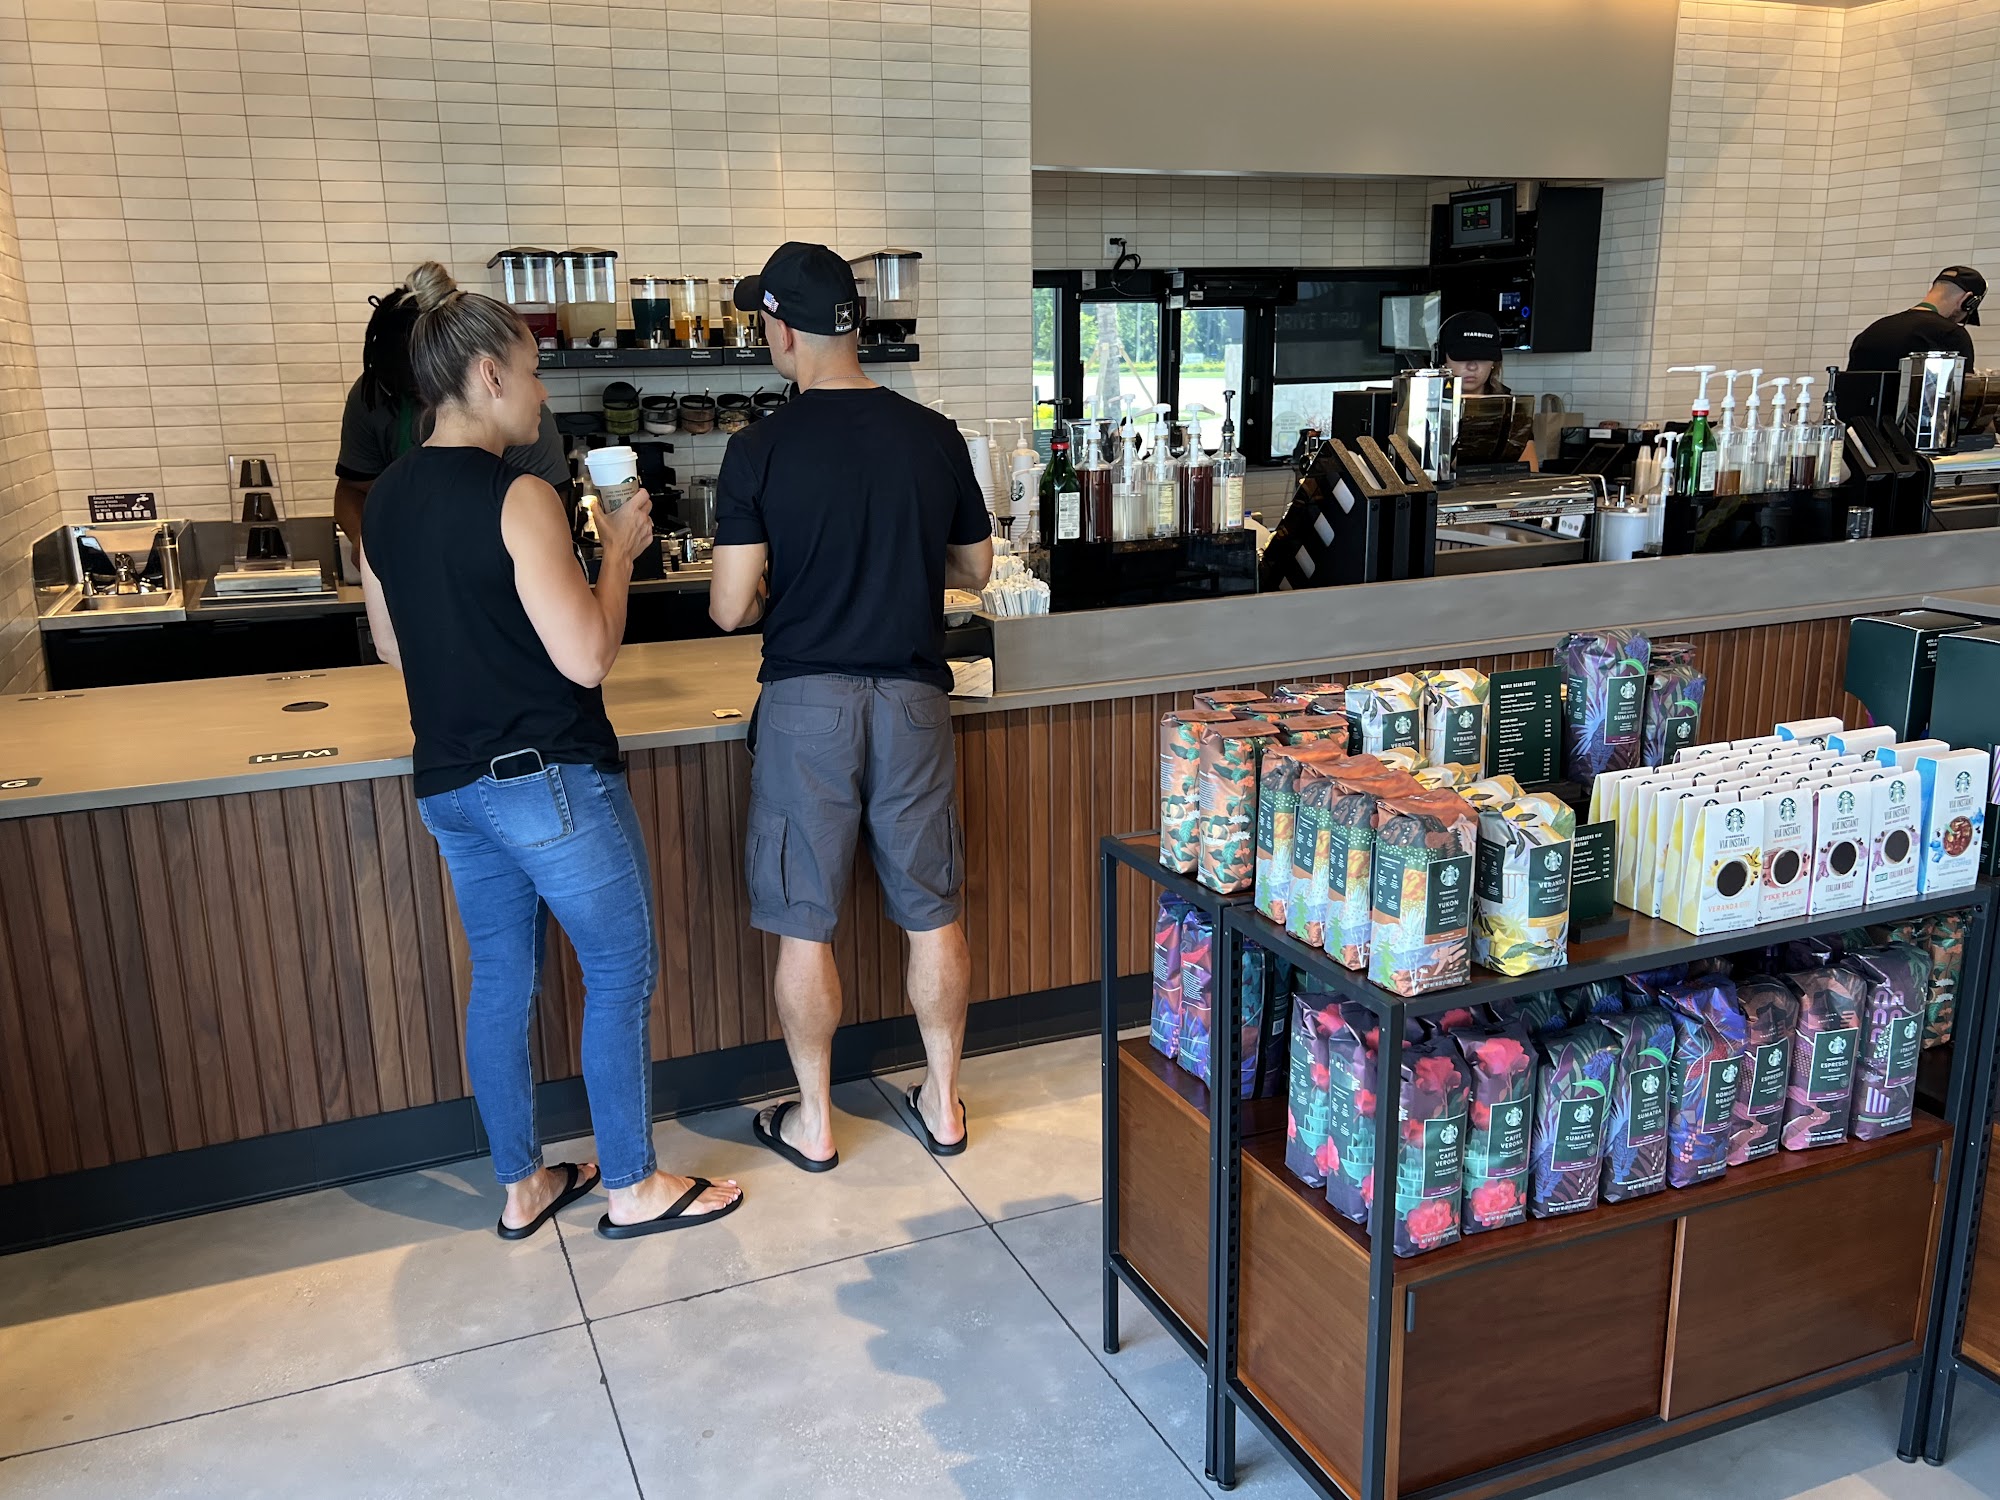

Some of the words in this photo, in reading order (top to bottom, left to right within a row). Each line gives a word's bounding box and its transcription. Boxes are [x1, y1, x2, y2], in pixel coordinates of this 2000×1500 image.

[1784, 826, 1801, 836] INSTANT
[1719, 840, 1728, 849] VIA
[1730, 837, 1750, 848] INSTANT
[1538, 878, 1566, 888] VERANDA
[1782, 889, 1803, 898] PLACE
[1438, 900, 1459, 908] YUKON
[1708, 902, 1738, 912] VERANDA
[1821, 1060, 1848, 1068] ESPRESSO
[1637, 1109, 1662, 1119] SUMATRA
[1565, 1133, 1594, 1141] SUMATRA
[1501, 1139, 1523, 1149] VERONA
[1435, 1158, 1458, 1167] VERONA
